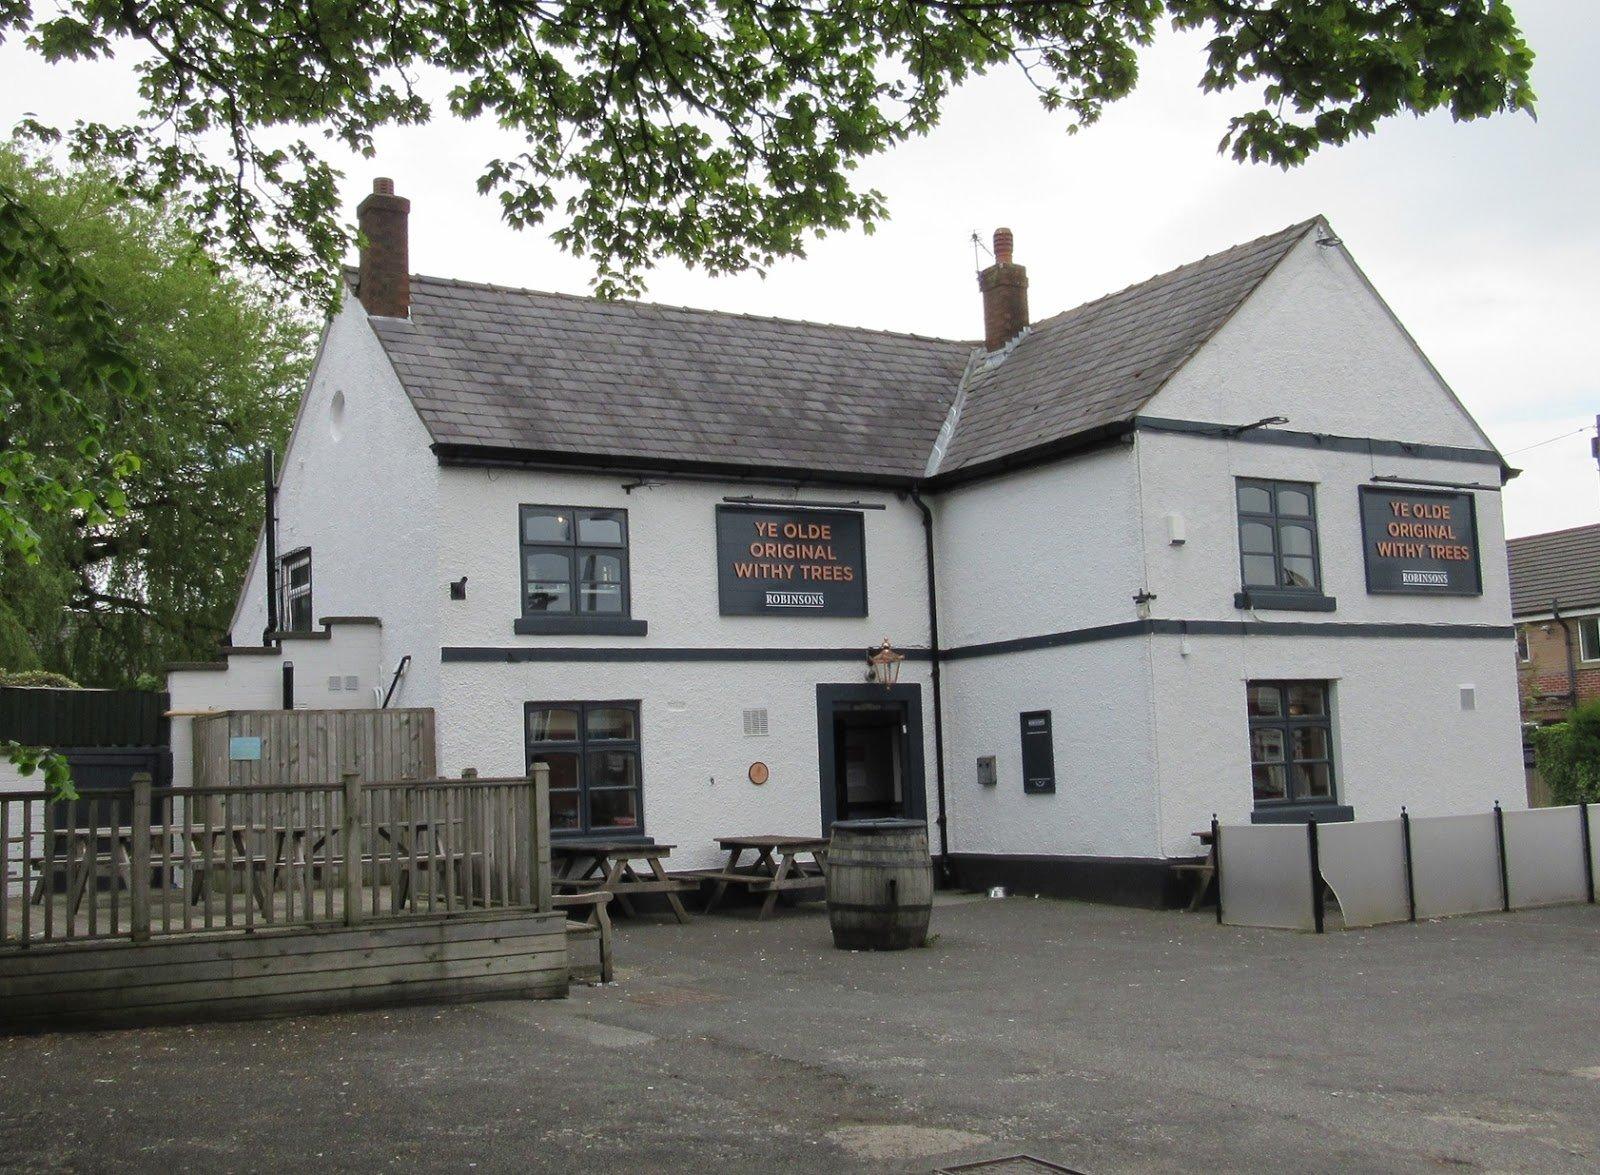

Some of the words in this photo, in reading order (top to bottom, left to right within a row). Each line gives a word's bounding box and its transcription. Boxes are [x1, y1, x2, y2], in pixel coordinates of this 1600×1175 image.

[1390, 501, 1409, 517] YE
[1413, 503, 1450, 519] OLDE
[754, 521, 778, 537] YE
[783, 523, 832, 540] OLDE
[1388, 522, 1456, 539] ORIGINAL
[750, 542, 836, 560] ORIGINAL
[1376, 542, 1424, 558] WITHY
[1428, 544, 1470, 560] TREES
[734, 562, 794, 580] WITHY
[800, 565, 853, 581] TREES
[1402, 572, 1448, 583] ROBINSONS
[766, 593, 824, 605] ROBINSONS
